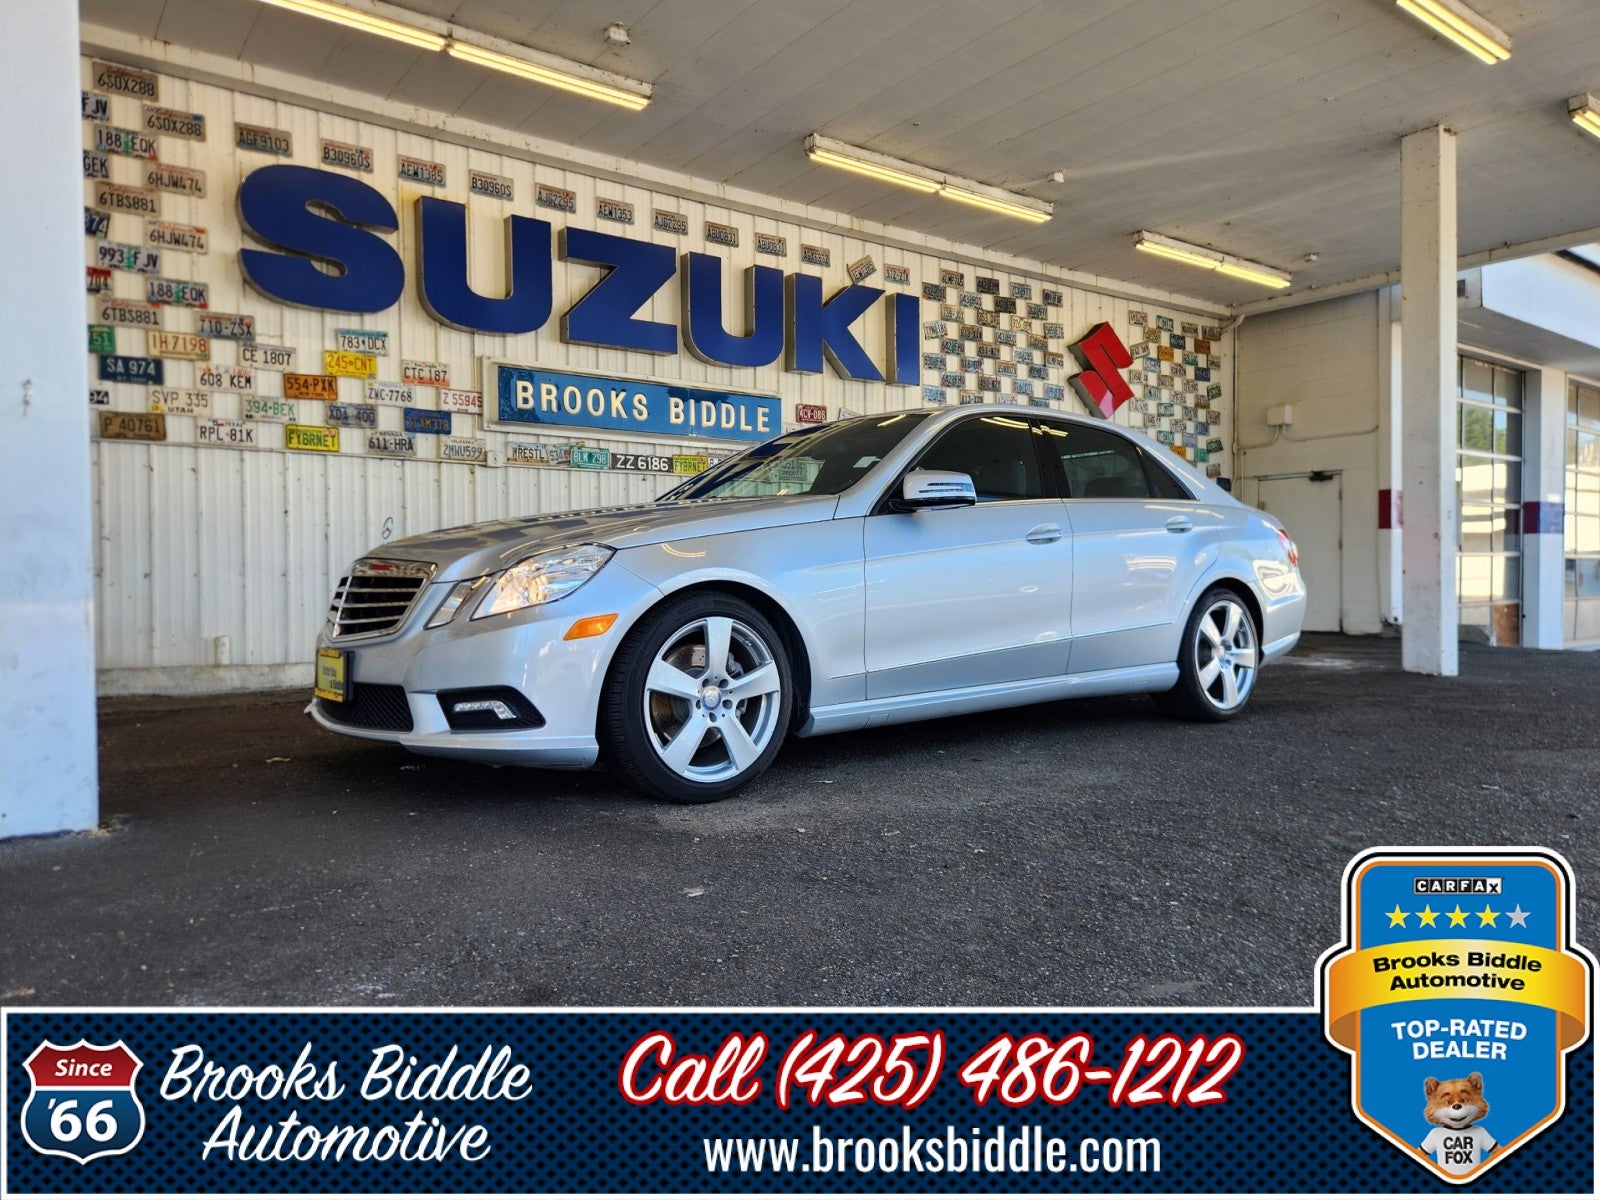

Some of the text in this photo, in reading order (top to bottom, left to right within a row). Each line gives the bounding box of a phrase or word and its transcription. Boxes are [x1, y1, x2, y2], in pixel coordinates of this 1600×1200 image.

[99, 246, 124, 264] 993
[236, 164, 920, 386] SUZUKI
[243, 348, 291, 366] CE 1807
[107, 358, 156, 376] SA 974
[404, 366, 448, 383] CTC 187
[200, 372, 252, 389] 608 KEM
[152, 390, 208, 408] SVP 335
[516, 381, 770, 433] BROOKS BIDDLE
[616, 455, 669, 471] ZZ 6186
